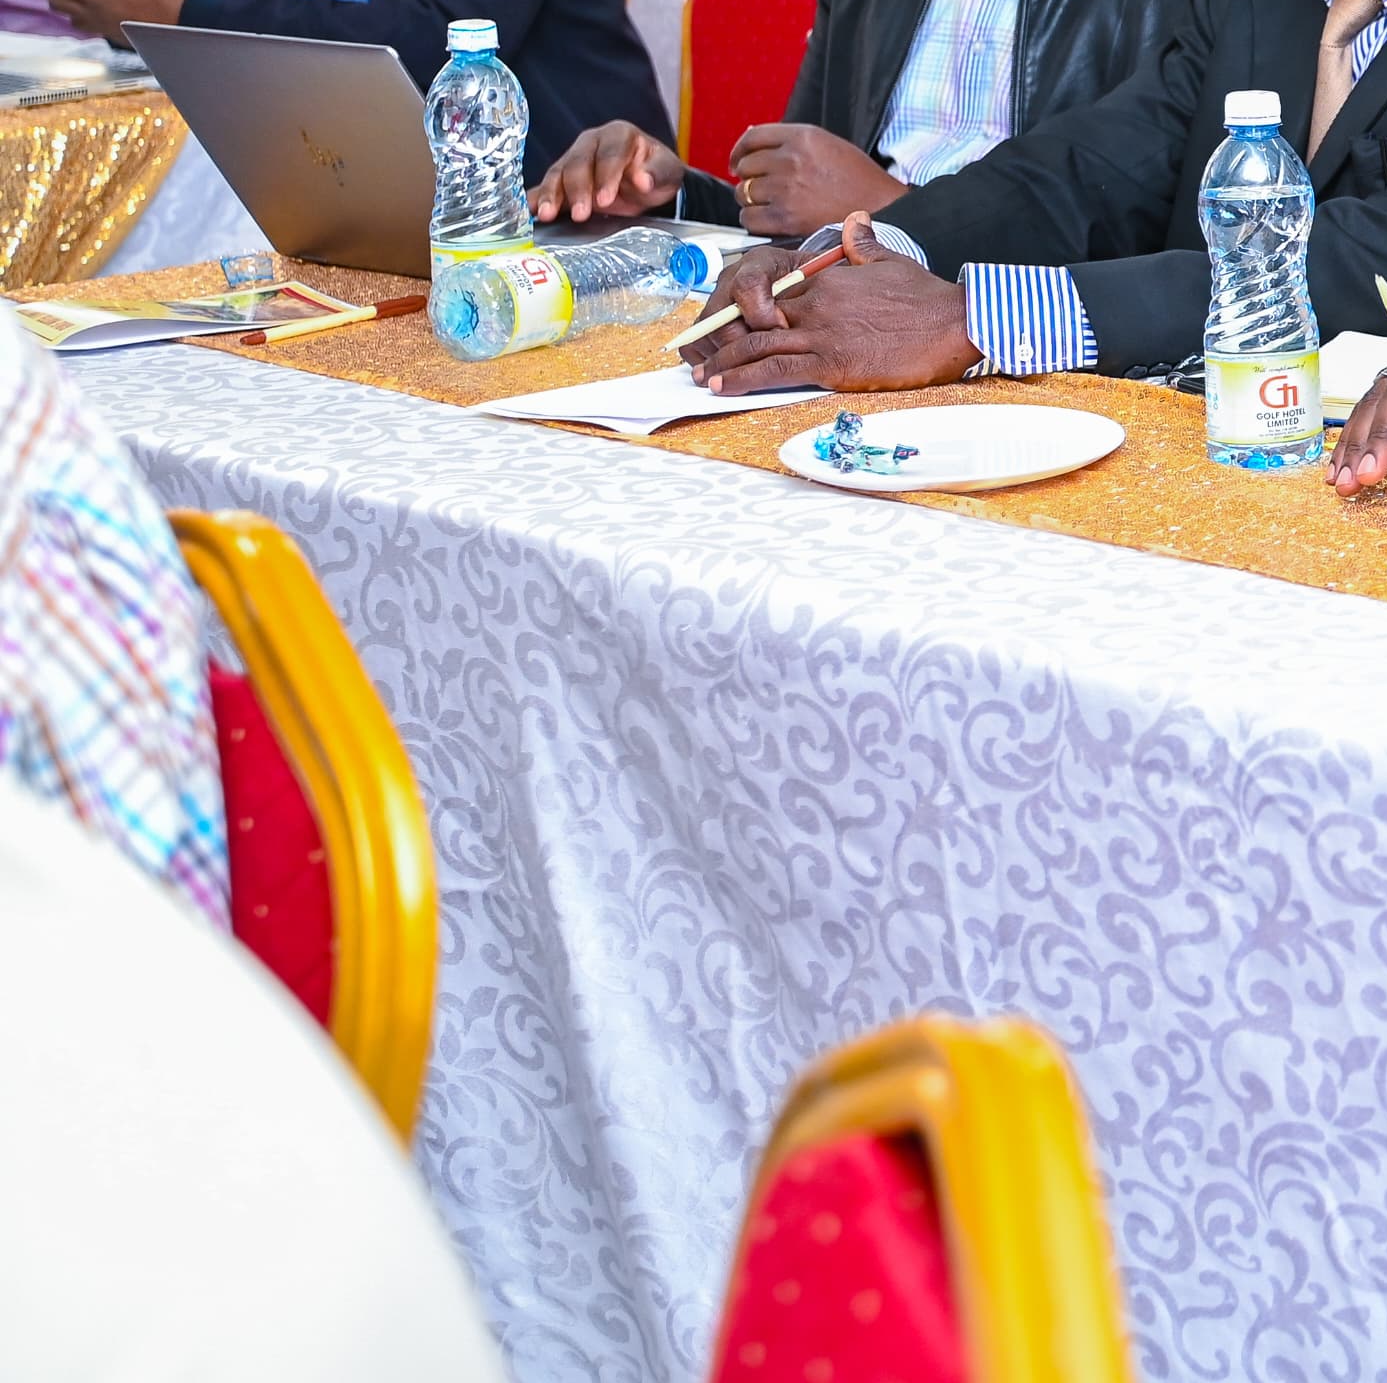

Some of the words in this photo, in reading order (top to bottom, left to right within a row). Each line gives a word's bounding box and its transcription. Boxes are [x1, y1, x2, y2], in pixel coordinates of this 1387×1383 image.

[1256, 412, 1280, 420] GOLF
[1282, 408, 1306, 418] HOTEL
[1267, 417, 1299, 428] LIMITED
